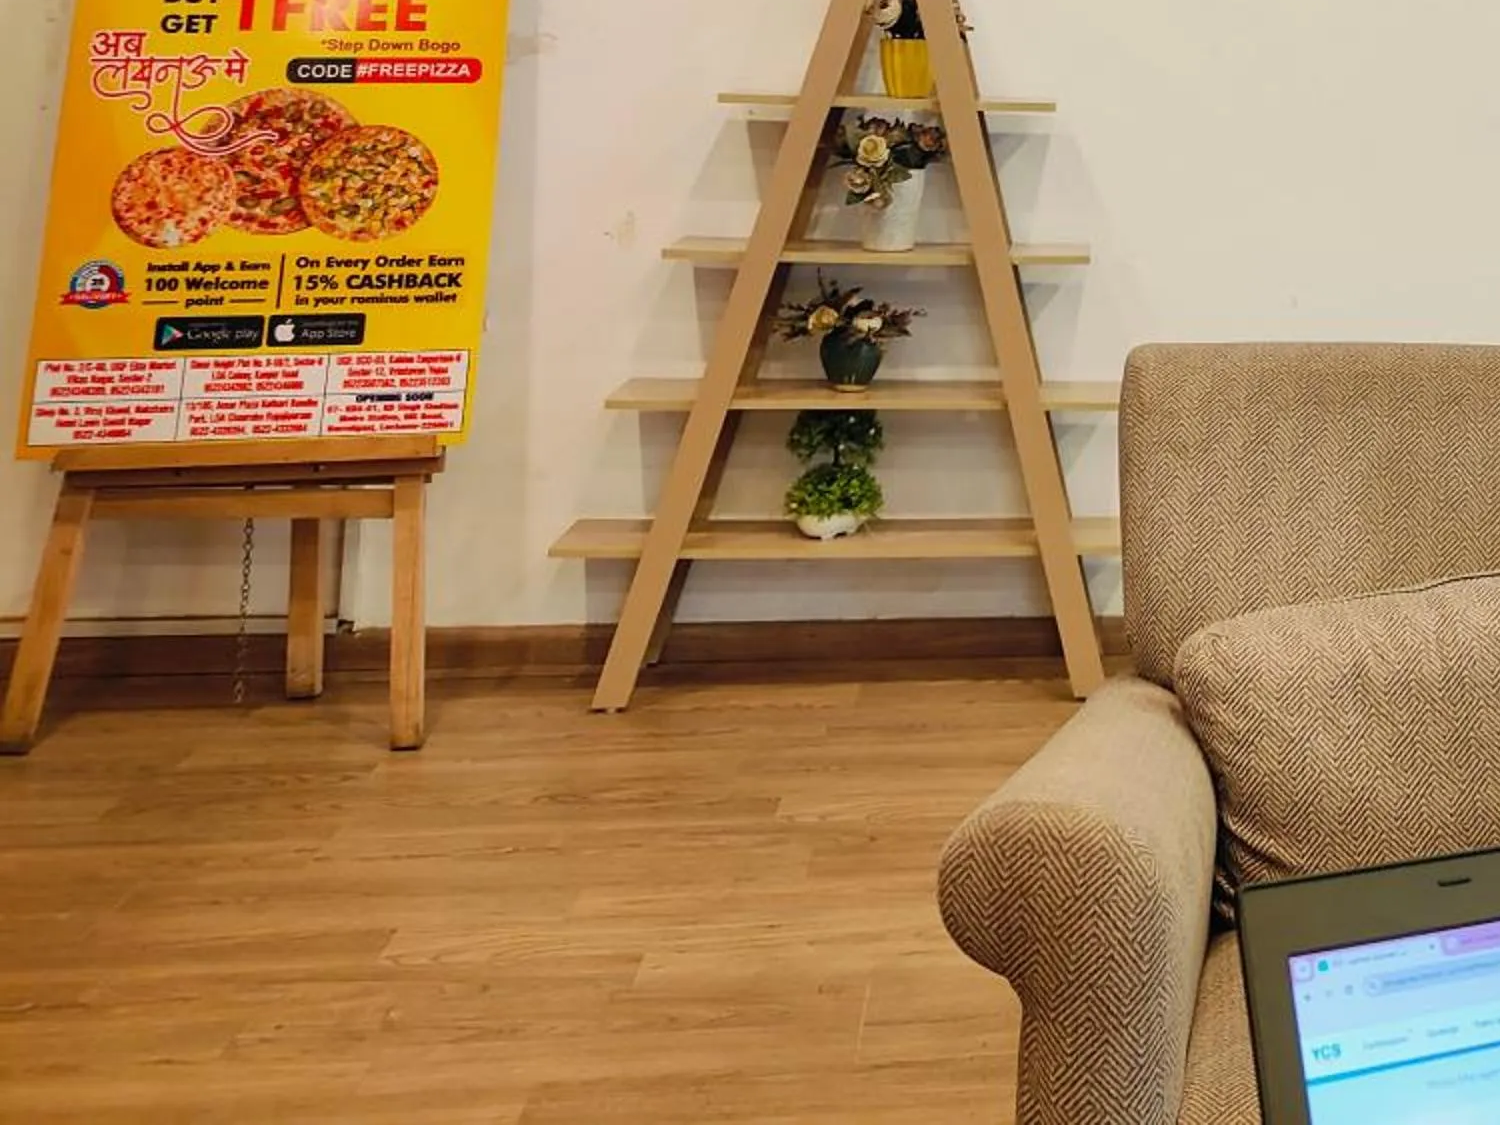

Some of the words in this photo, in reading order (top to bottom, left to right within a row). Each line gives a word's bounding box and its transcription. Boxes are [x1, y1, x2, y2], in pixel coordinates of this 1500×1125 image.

[160, 13, 219, 34] GET
[92, 31, 148, 57] अब
[368, 39, 414, 52] Down
[418, 38, 461, 54] Bogo
[296, 63, 353, 79] CODE
[356, 62, 472, 78] #FREEPIZZA
[146, 261, 189, 272] Install
[192, 262, 222, 275] App
[224, 261, 235, 272] &
[239, 260, 271, 271] Earn
[295, 255, 321, 268] On
[326, 256, 371, 271] Every
[374, 254, 423, 268] Order
[428, 254, 466, 267] Earn
[144, 277, 179, 292] 100
[184, 276, 271, 291] Welcome
[293, 273, 339, 291] 15%
[345, 272, 463, 290] CASHBACK
[184, 296, 225, 309] point
[294, 295, 310, 306] in
[313, 295, 347, 308] your
[350, 293, 410, 304] rominus
[413, 291, 458, 304] wallet
[186, 327, 231, 344] Google
[300, 328, 325, 340] App
[327, 327, 358, 339] Store
[1311, 1042, 1342, 1061] YCS
